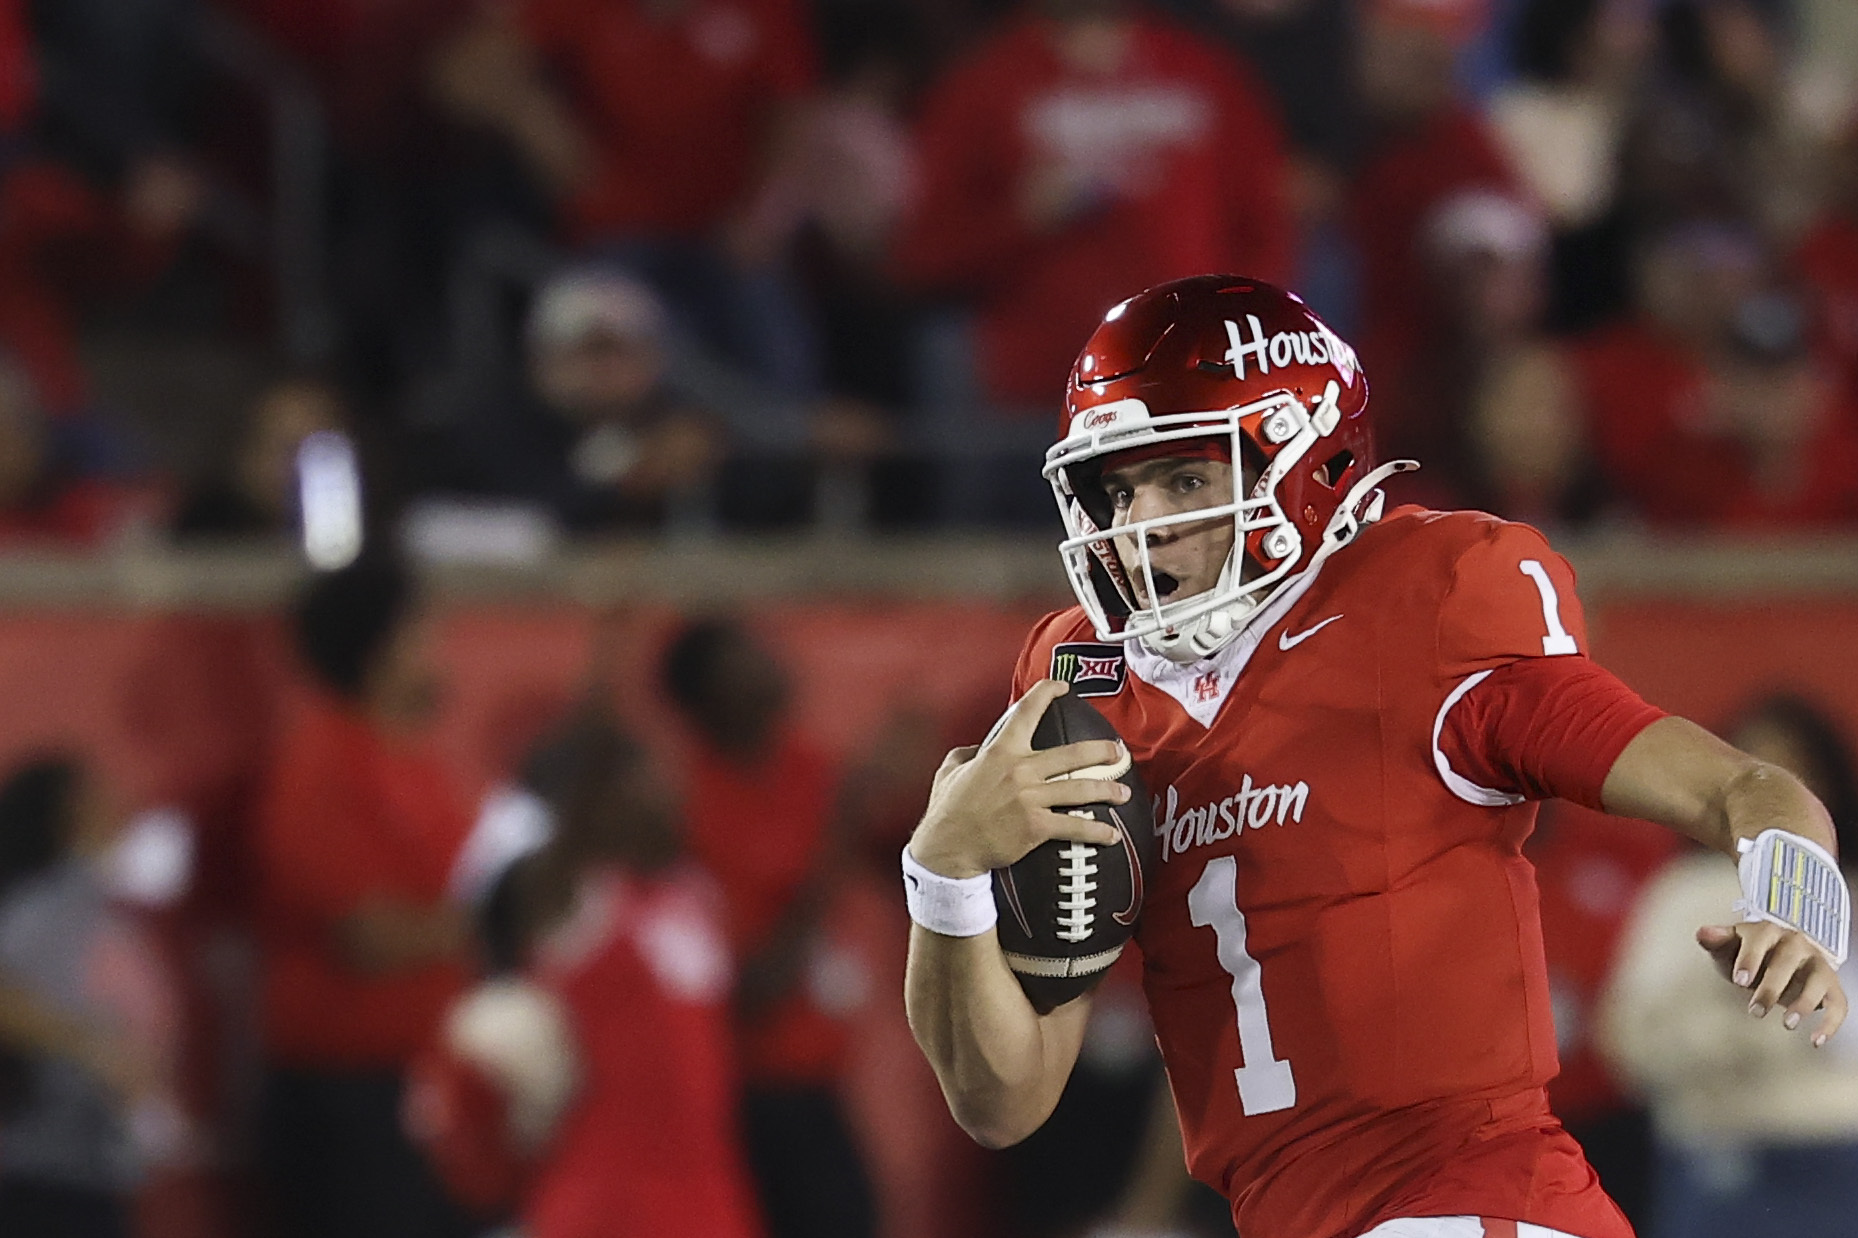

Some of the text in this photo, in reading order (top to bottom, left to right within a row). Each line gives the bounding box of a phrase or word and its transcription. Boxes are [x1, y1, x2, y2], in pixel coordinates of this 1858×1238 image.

[1519, 559, 1579, 656] 1
[1077, 657, 1119, 680] XII
[1152, 773, 1310, 863] Houston
[1188, 855, 1297, 1117] 1
